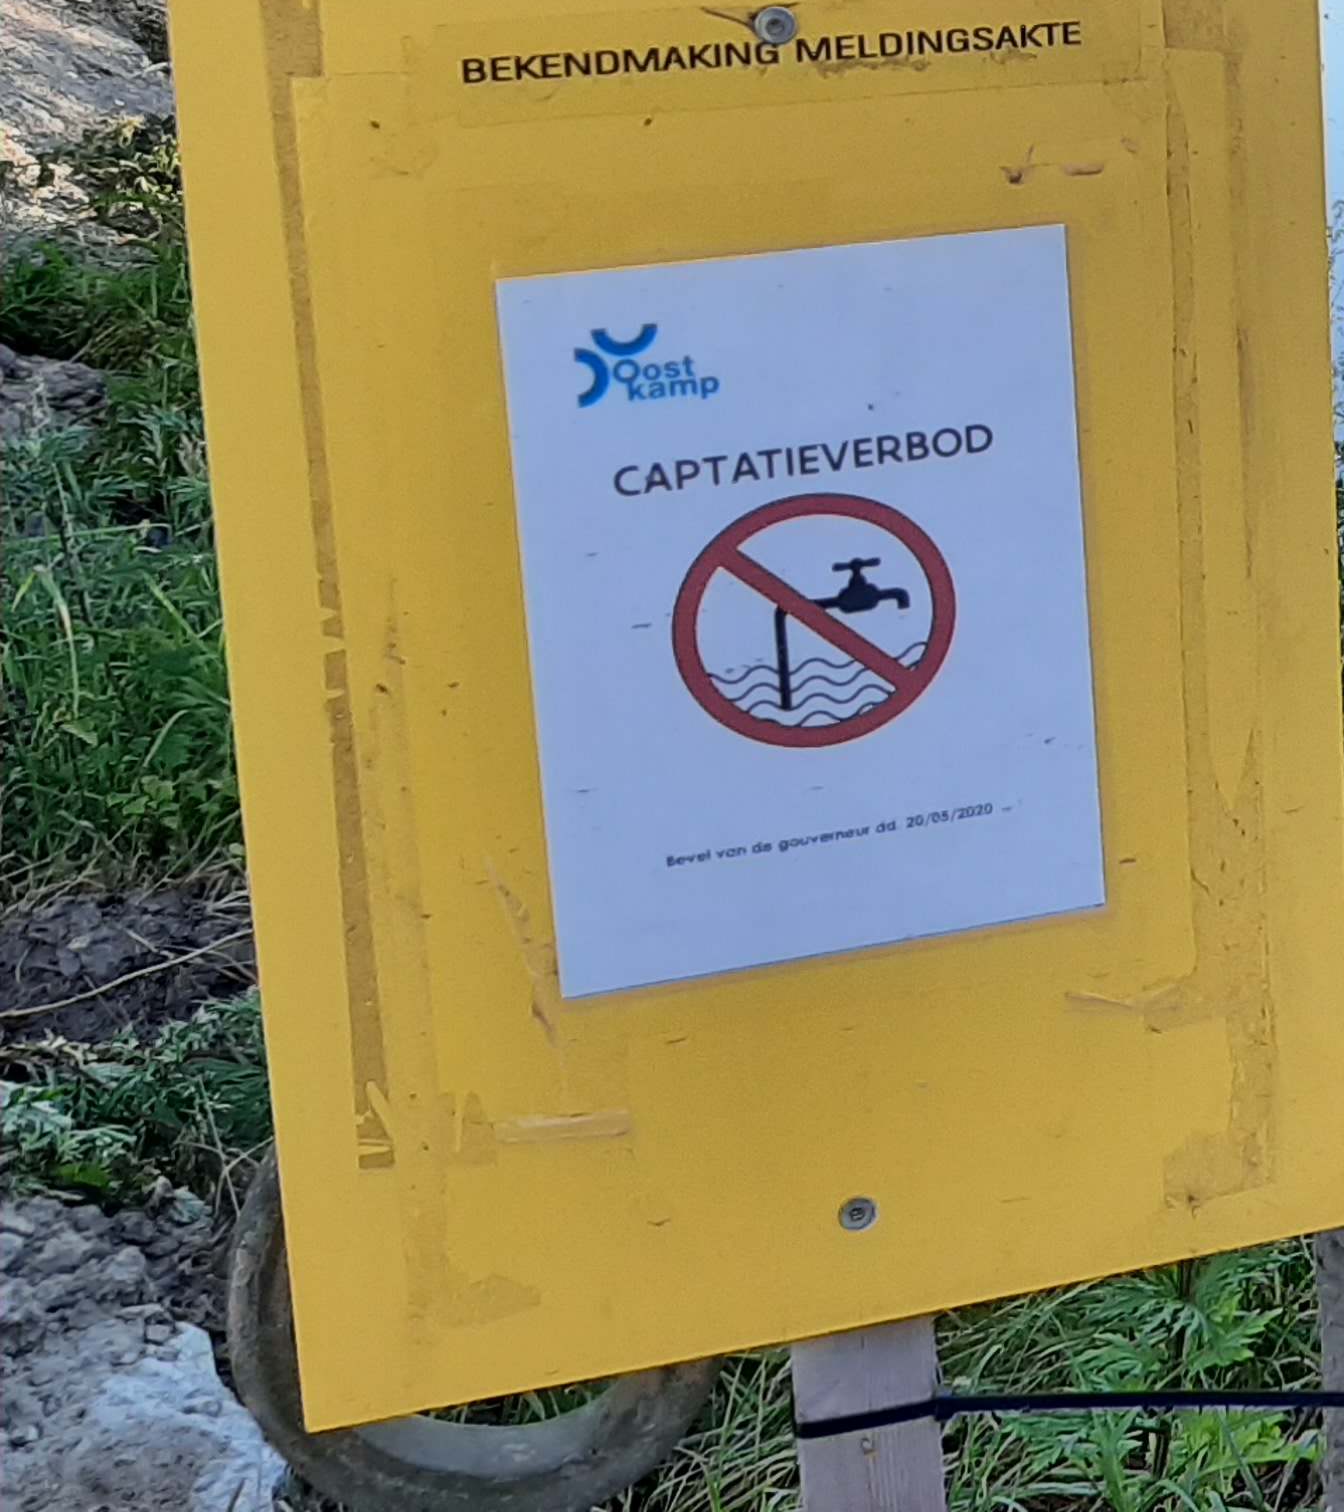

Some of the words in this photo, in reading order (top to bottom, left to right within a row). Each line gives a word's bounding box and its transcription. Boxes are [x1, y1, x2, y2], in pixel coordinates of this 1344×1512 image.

[461, 38, 780, 85] BEKENDMAKING
[795, 20, 1083, 63] MELDINGSAKTE
[612, 355, 695, 384] Oost
[627, 376, 720, 402] kamp
[612, 423, 995, 497] CAPTATIEVERBOD
[665, 849, 712, 868] Bevel
[716, 846, 748, 860] van
[751, 841, 773, 855] de
[778, 825, 871, 853] gouverneur
[905, 802, 994, 829] 20/05/2020
